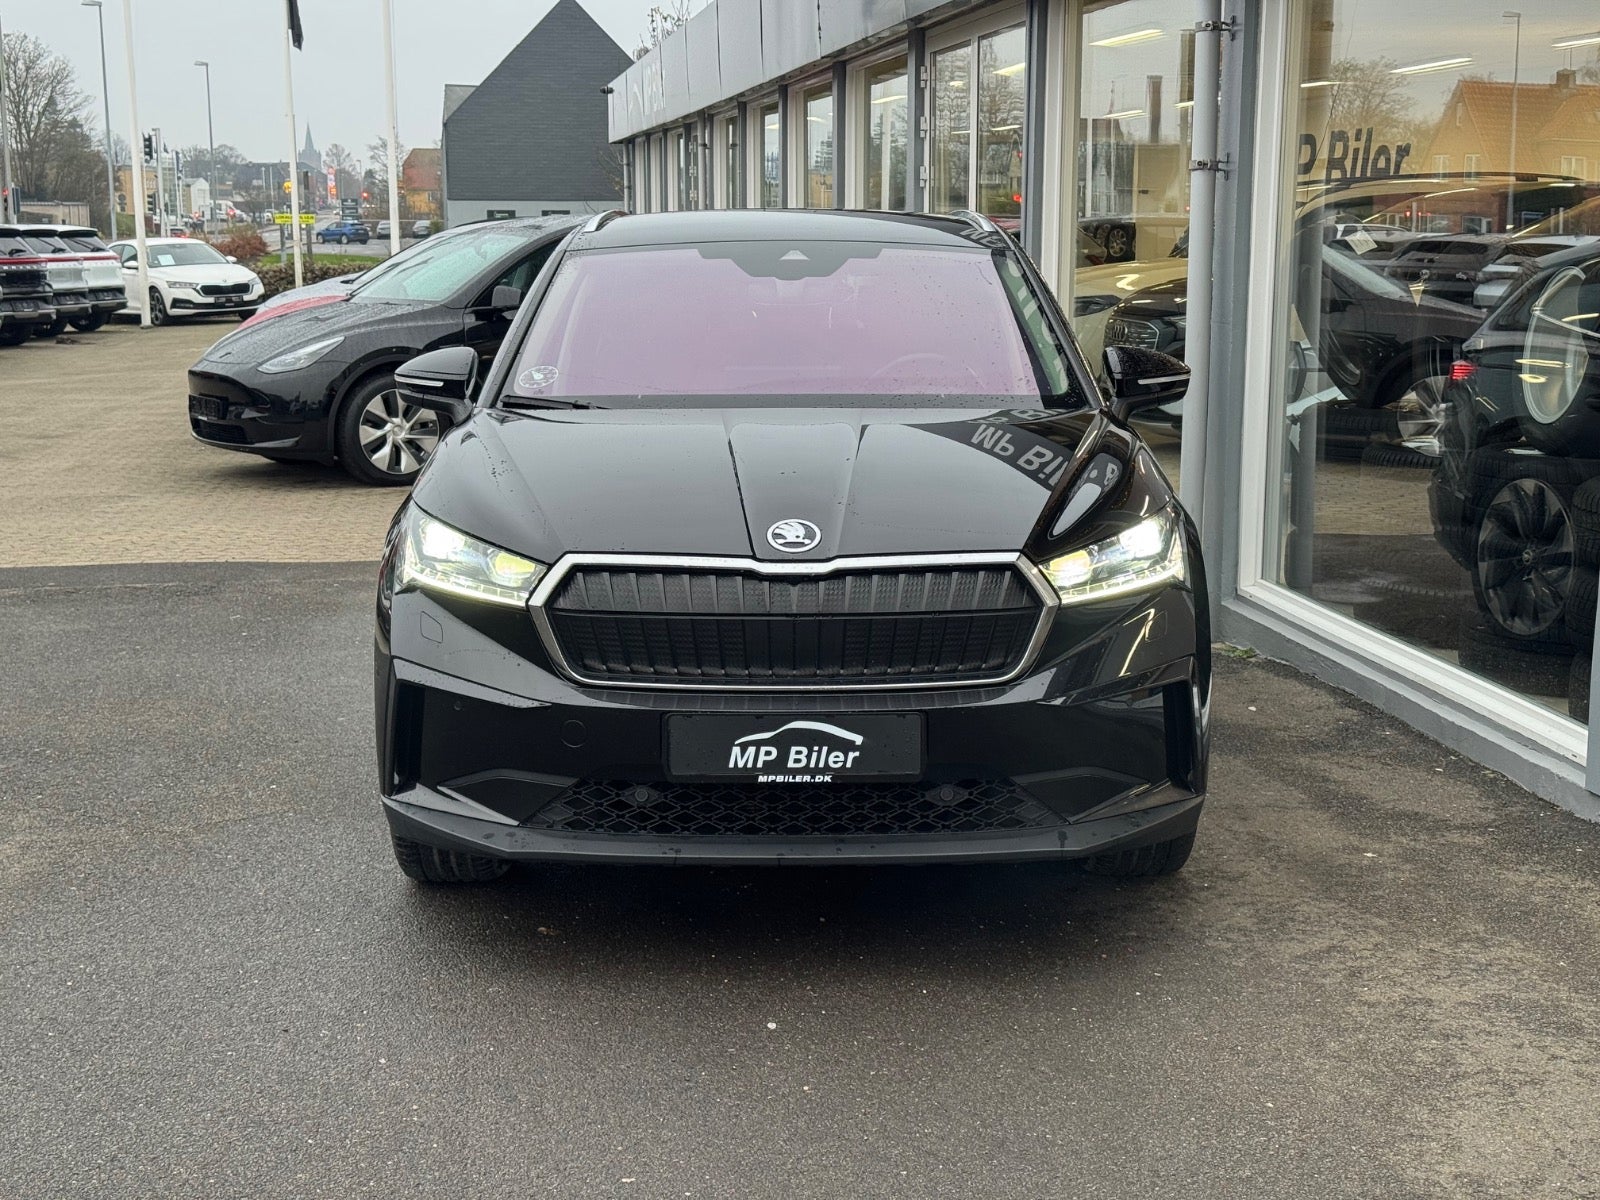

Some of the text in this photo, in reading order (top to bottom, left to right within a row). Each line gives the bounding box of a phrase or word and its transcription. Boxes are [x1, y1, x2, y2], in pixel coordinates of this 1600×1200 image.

[1298, 133, 1317, 175] P
[728, 746, 860, 768] MP Biler
[757, 775, 833, 783] MPBILER.DK
